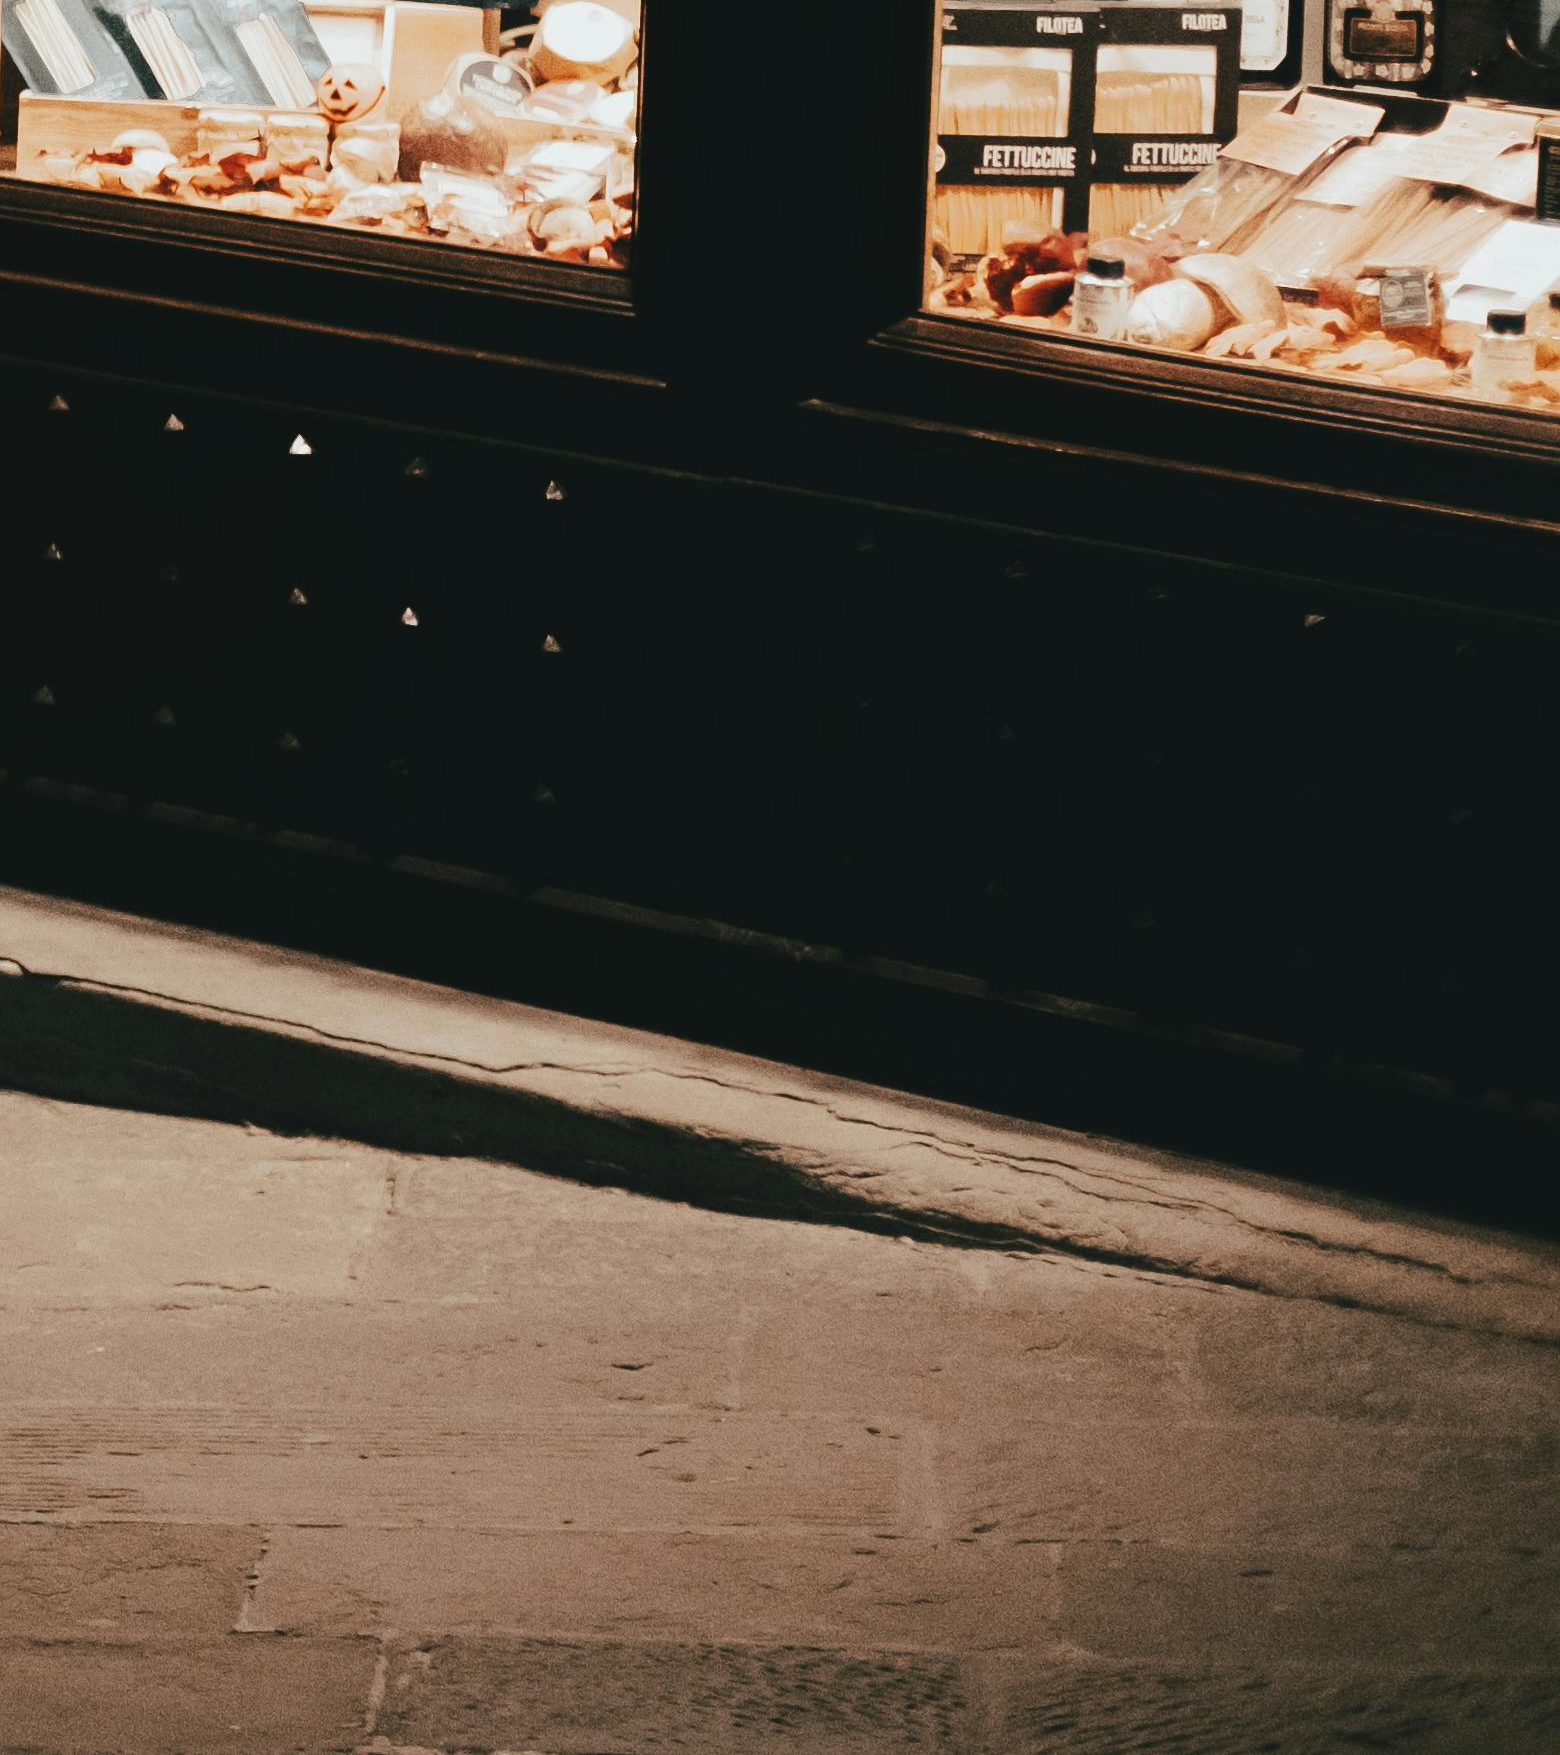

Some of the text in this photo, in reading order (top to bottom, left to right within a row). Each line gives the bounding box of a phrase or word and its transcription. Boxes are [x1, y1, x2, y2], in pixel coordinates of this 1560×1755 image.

[1036, 15, 1084, 37] FILOTEA
[1181, 13, 1228, 33] FILOTEA
[983, 144, 1077, 170] FETTUCCINE
[1131, 142, 1224, 167] FETTUCCINE
